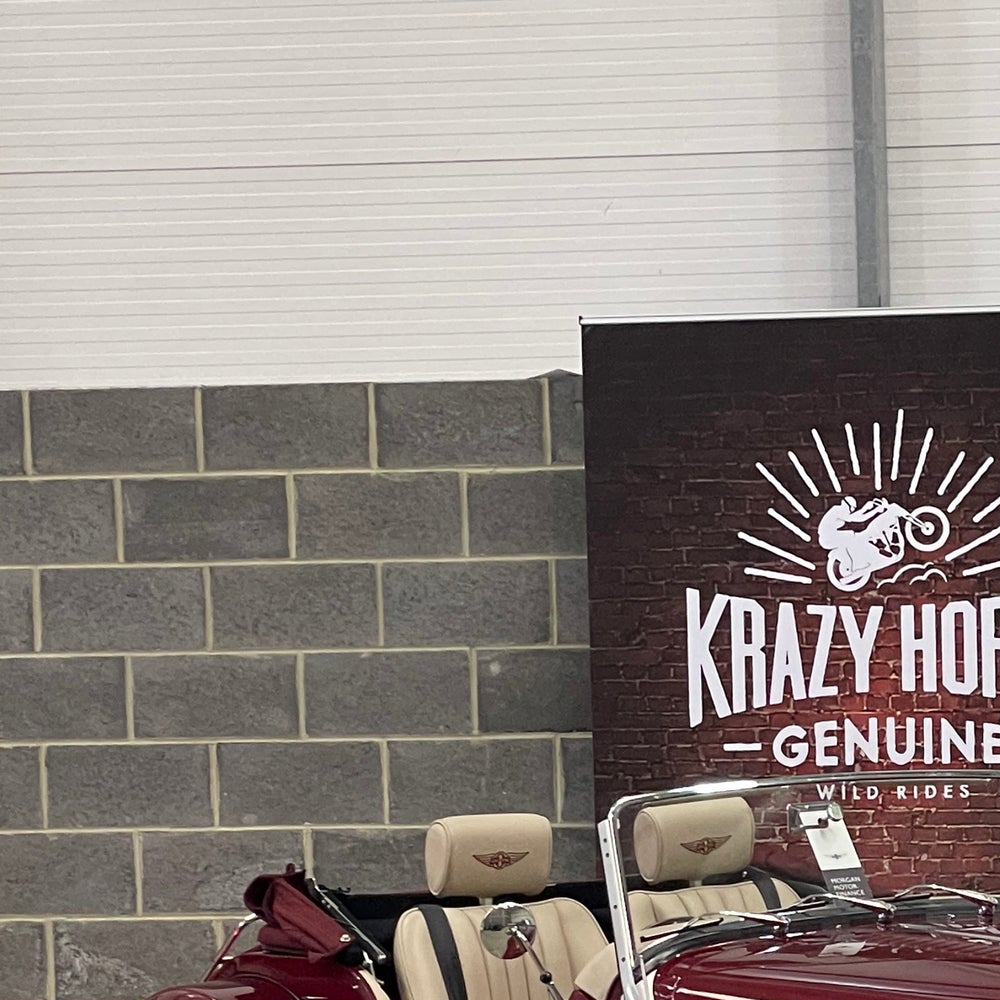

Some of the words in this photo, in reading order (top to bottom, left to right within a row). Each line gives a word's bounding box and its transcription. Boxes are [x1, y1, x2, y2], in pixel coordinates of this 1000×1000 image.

[686, 587, 883, 727] KRAZY
[816, 783, 879, 801] WILD
[897, 783, 970, 800] RIDES
[830, 876, 861, 884] MORGAN
[833, 883, 859, 891] MOTOR
